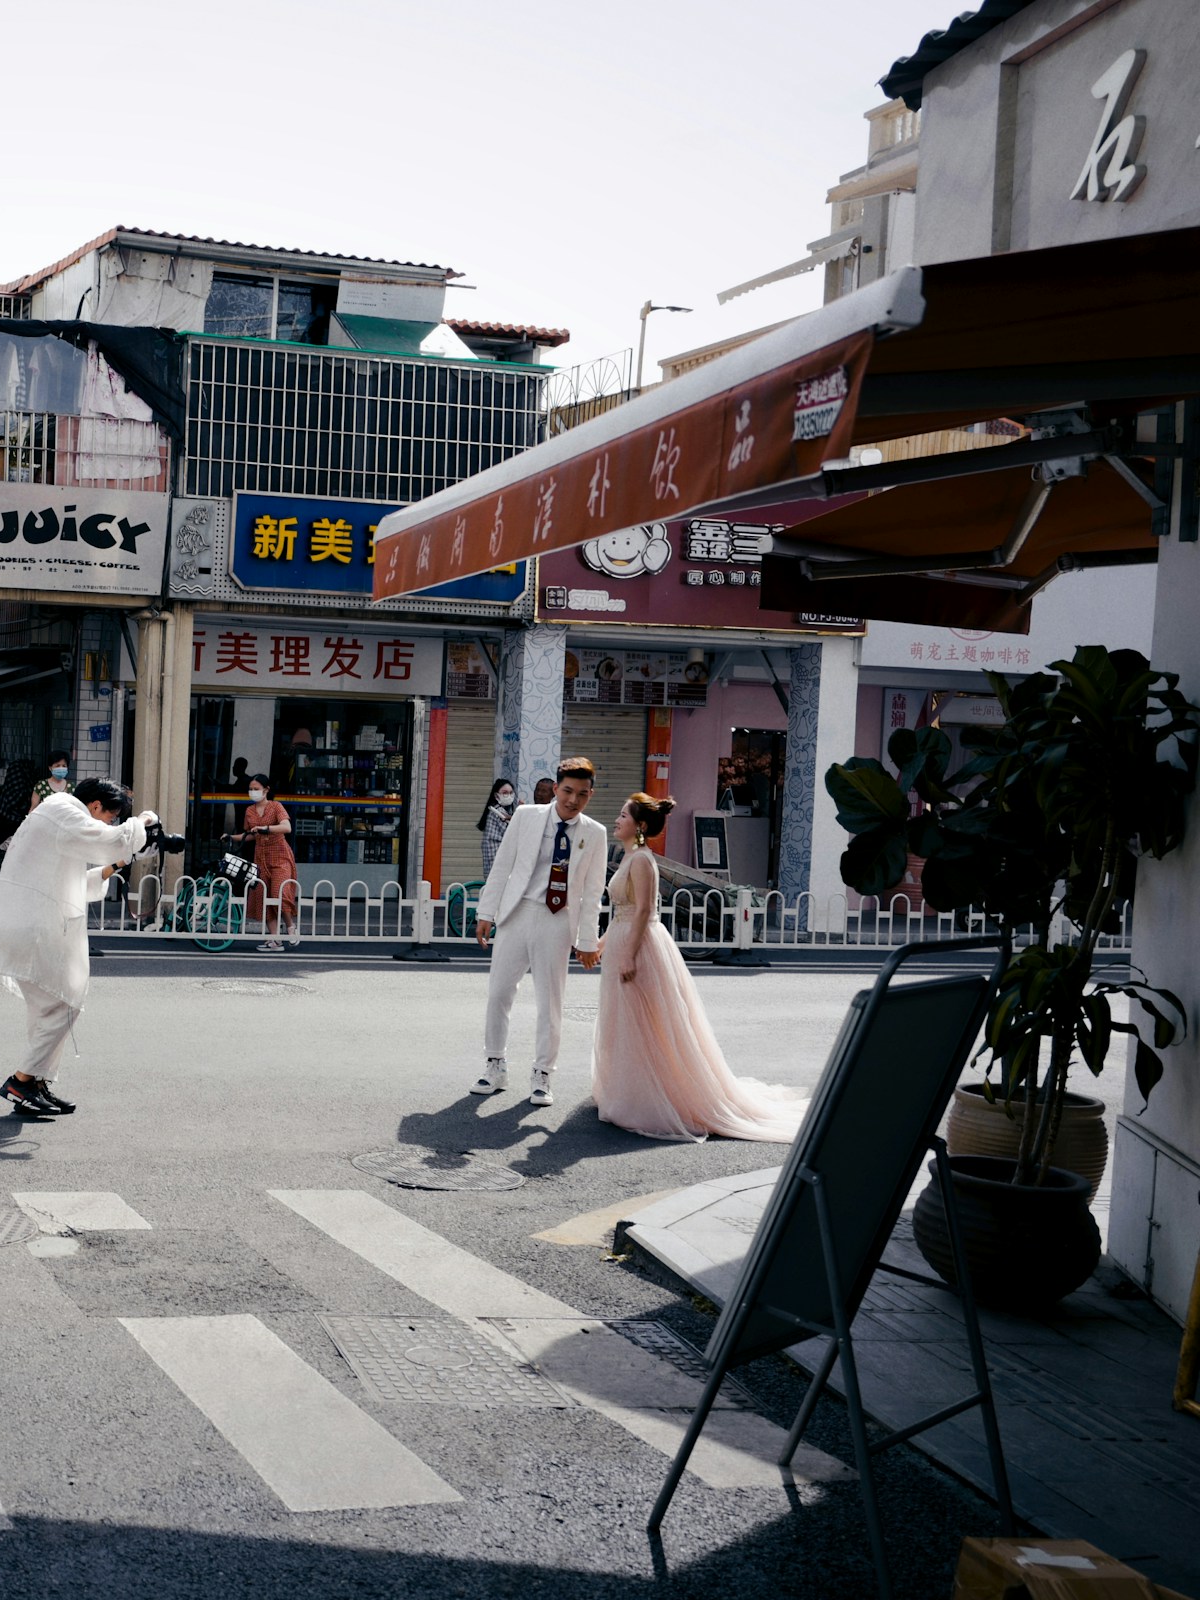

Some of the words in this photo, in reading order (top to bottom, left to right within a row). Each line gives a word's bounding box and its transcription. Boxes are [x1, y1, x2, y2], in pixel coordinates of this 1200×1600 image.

[253, 514, 376, 564] 新美
[688, 518, 786, 562] 鑫三
[45, 557, 92, 567] CHEESE
[99, 561, 141, 571] COFFEE
[910, 642, 1031, 665] 萌宠主题咖啡馆
